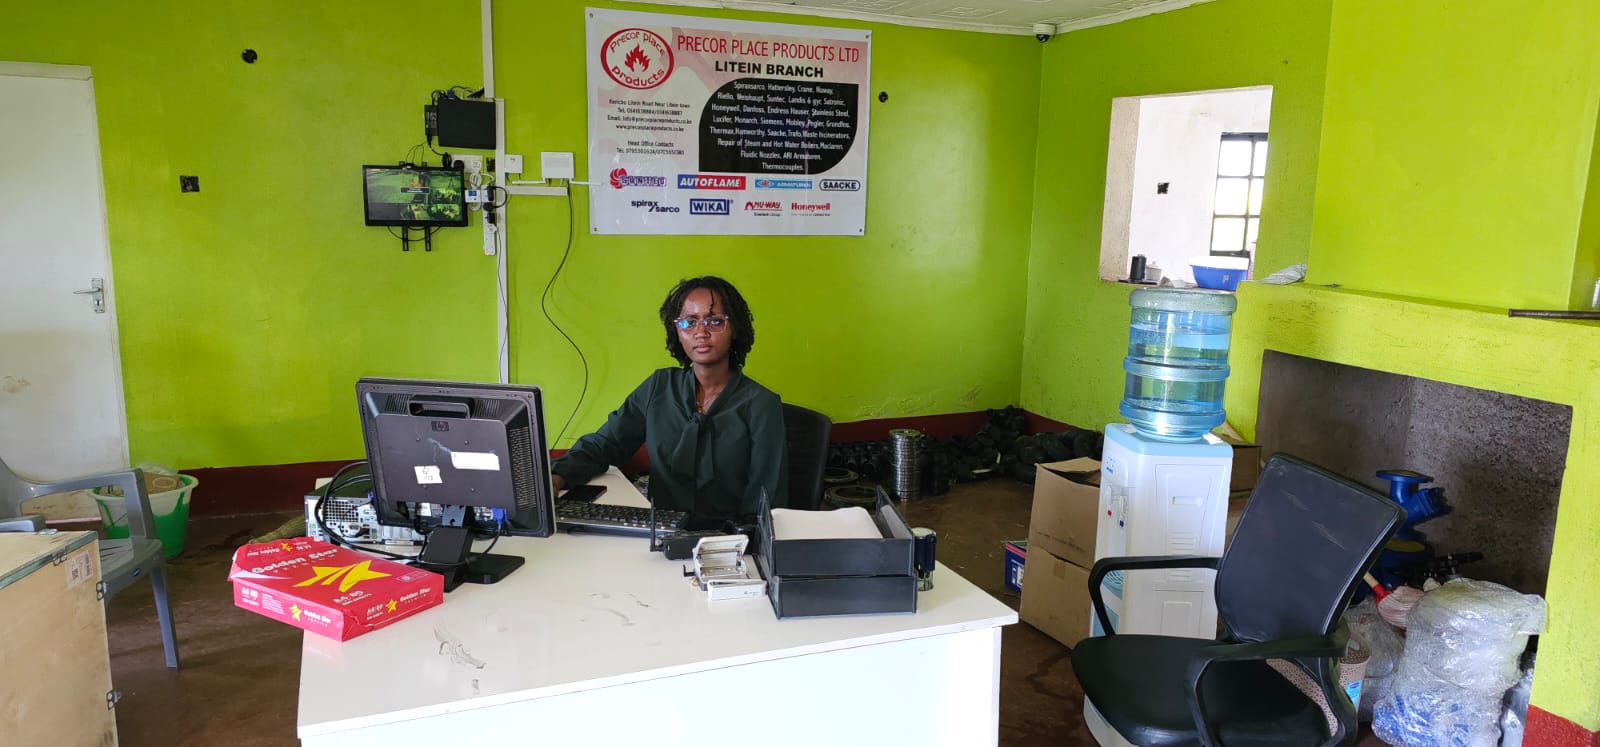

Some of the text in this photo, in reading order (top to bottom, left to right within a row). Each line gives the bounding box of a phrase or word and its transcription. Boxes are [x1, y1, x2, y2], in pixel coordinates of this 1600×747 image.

[677, 35, 859, 63] PRECOR PLACE PRODUCTS LTD
[715, 60, 824, 78] LITEIN BRANCH
[767, 105, 789, 115] Endress
[717, 138, 735, 147] Repair
[744, 139, 760, 147] Steam
[773, 140, 783, 148] Hot
[784, 140, 799, 148] Water
[782, 151, 792, 159] ARI
[679, 177, 741, 188] AUTOFLAME
[822, 181, 857, 190] SAACKE
[631, 200, 658, 208] spirax
[692, 202, 722, 212] WIKA
[791, 202, 831, 212] Honeywell
[251, 557, 307, 574] Golden
[308, 548, 338, 559] Star
[400, 591, 418, 602] Golden
[303, 609, 320, 620] Golden
